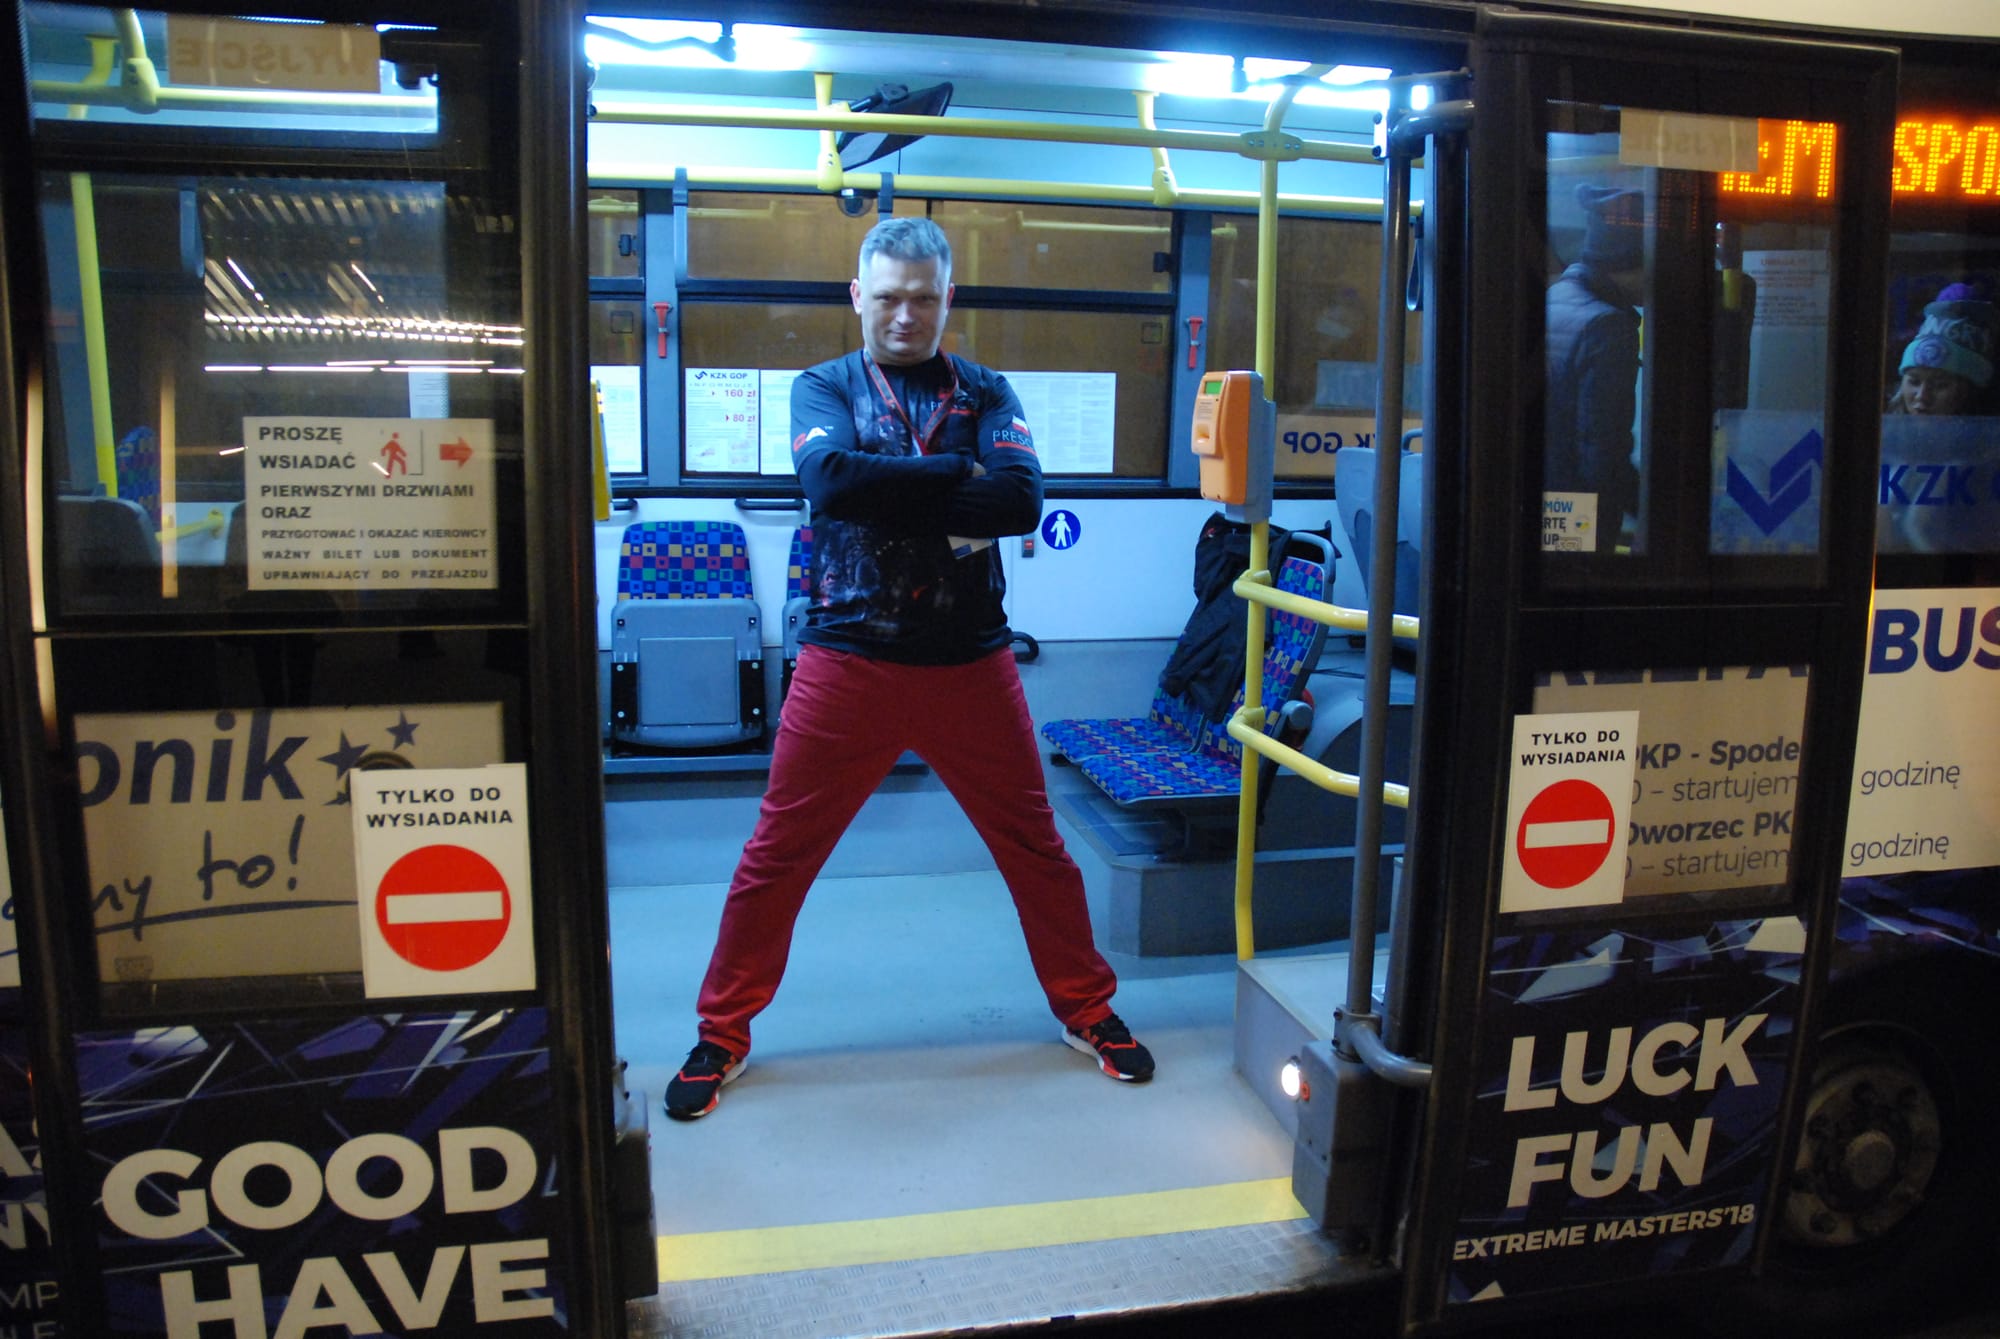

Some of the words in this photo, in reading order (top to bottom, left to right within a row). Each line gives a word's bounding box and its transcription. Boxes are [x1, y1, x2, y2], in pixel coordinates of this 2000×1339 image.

[1893, 121, 2000, 195] SPO
[730, 372, 748, 380] GOP
[725, 389, 743, 397] 160
[733, 414, 744, 422] 80
[259, 427, 342, 444] PROSZĘ
[260, 452, 356, 469] WSIADAĆ
[261, 485, 376, 497] PIERWSZYMI
[383, 485, 474, 497] DRZWIAMI
[1880, 464, 1975, 505] KZK
[262, 507, 311, 519] ORAZ
[423, 529, 487, 538] KIEROWCY
[323, 549, 361, 559] BILET
[374, 549, 400, 559] LUB
[412, 549, 487, 559] DOKUMENT
[263, 570, 370, 581] UPRAWNIAJĄCY
[382, 570, 400, 580] DO
[411, 569, 488, 579] PRZEJAZDU
[1531, 731, 1587, 746] TYLKO
[1597, 730, 1620, 743] DO
[1520, 750, 1626, 765] WYSIADANIA
[1635, 743, 1681, 770] KP
[1860, 762, 1961, 795] godzinę
[377, 788, 455, 804] TYLKO
[470, 787, 501, 802] DO
[366, 809, 514, 828] WYSIADANIA
[1850, 832, 1950, 866] godzinę
[1503, 1013, 1769, 1112] LUCK
[1506, 1117, 1714, 1208] FUN
[102, 1126, 537, 1240] GOOD
[1453, 1225, 1585, 1260] EXTREME
[1594, 1203, 1755, 1243] MASTERS'18
[159, 1238, 555, 1339] HAVE
